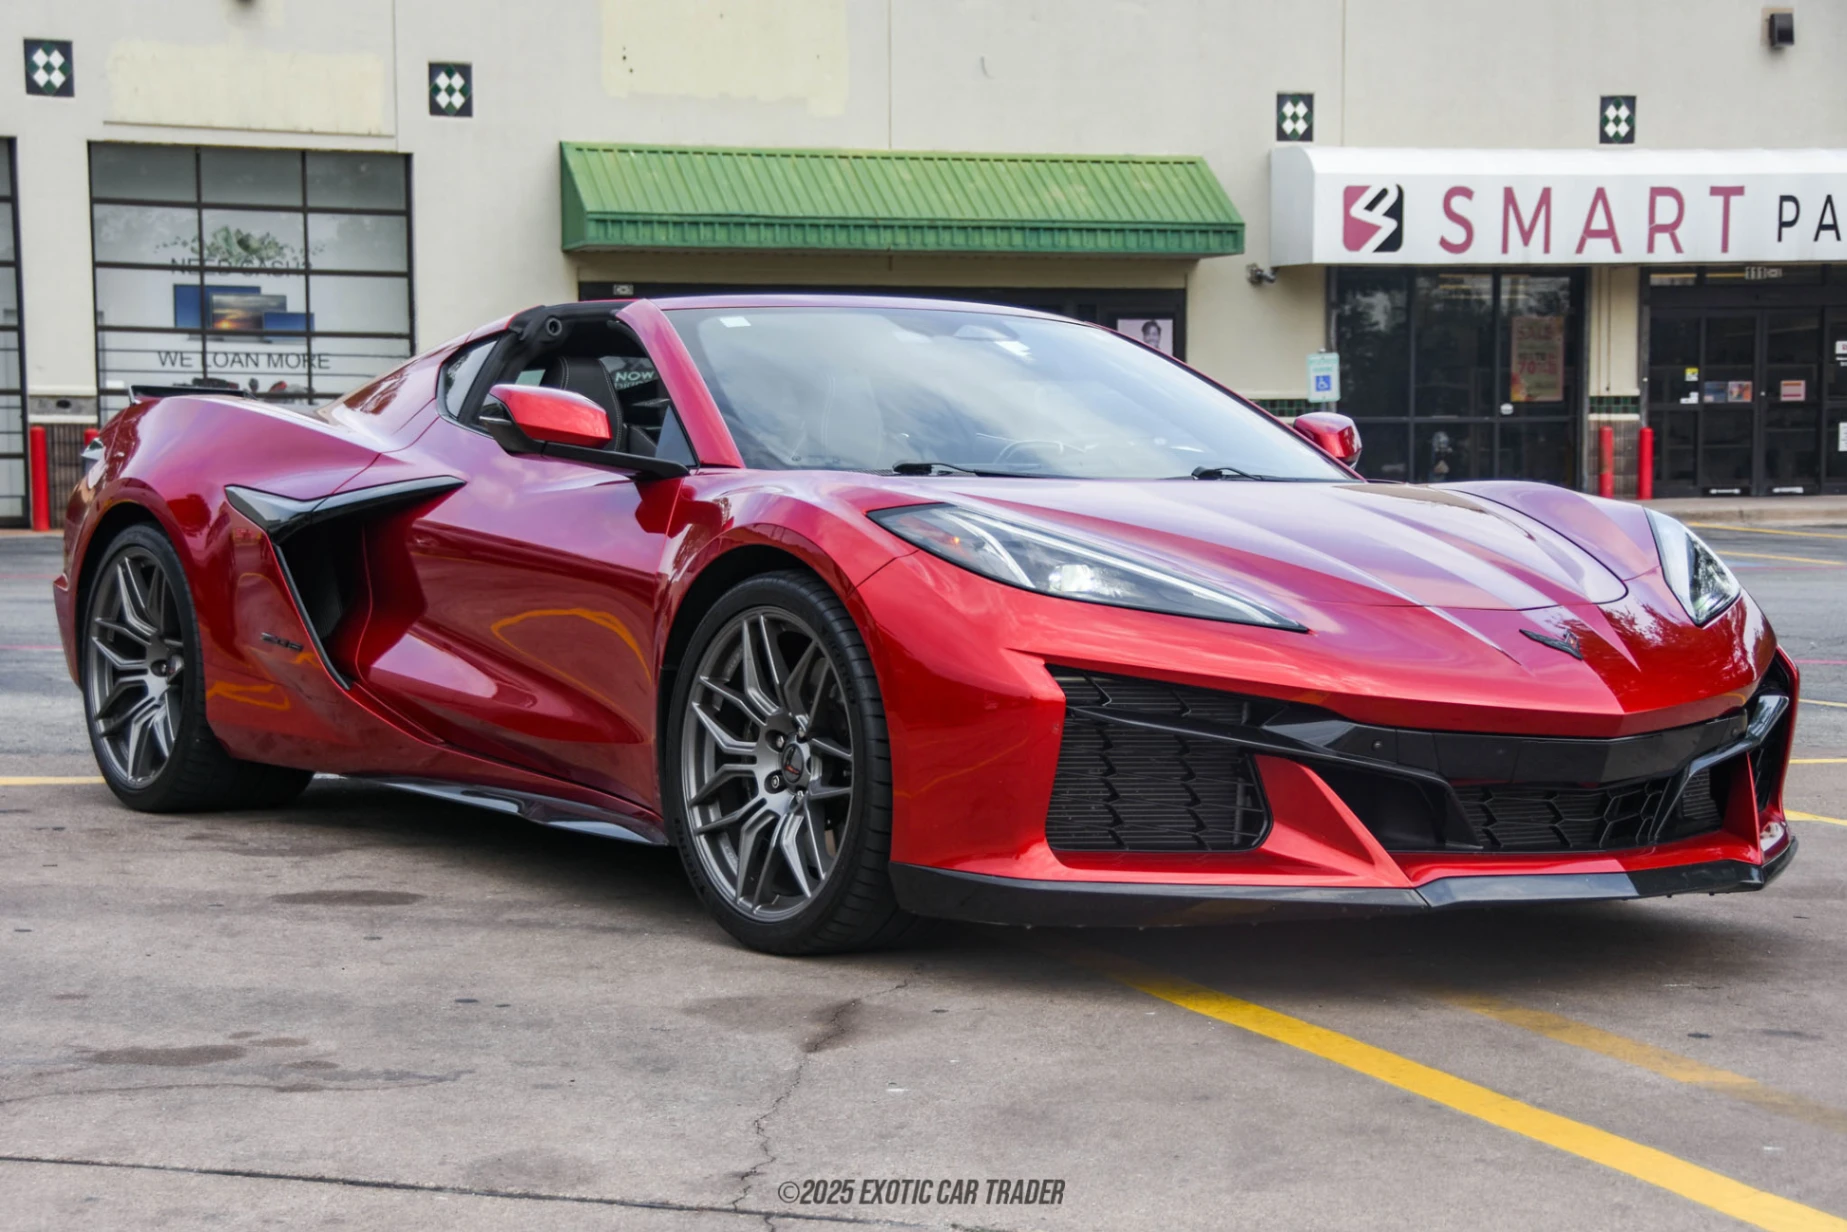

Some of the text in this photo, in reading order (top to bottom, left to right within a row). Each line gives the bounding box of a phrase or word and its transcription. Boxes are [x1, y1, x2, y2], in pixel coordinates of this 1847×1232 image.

[1439, 185, 1842, 254] SMART PA
[158, 352, 331, 369] WE OAN MORE
[615, 371, 654, 382] NOW
